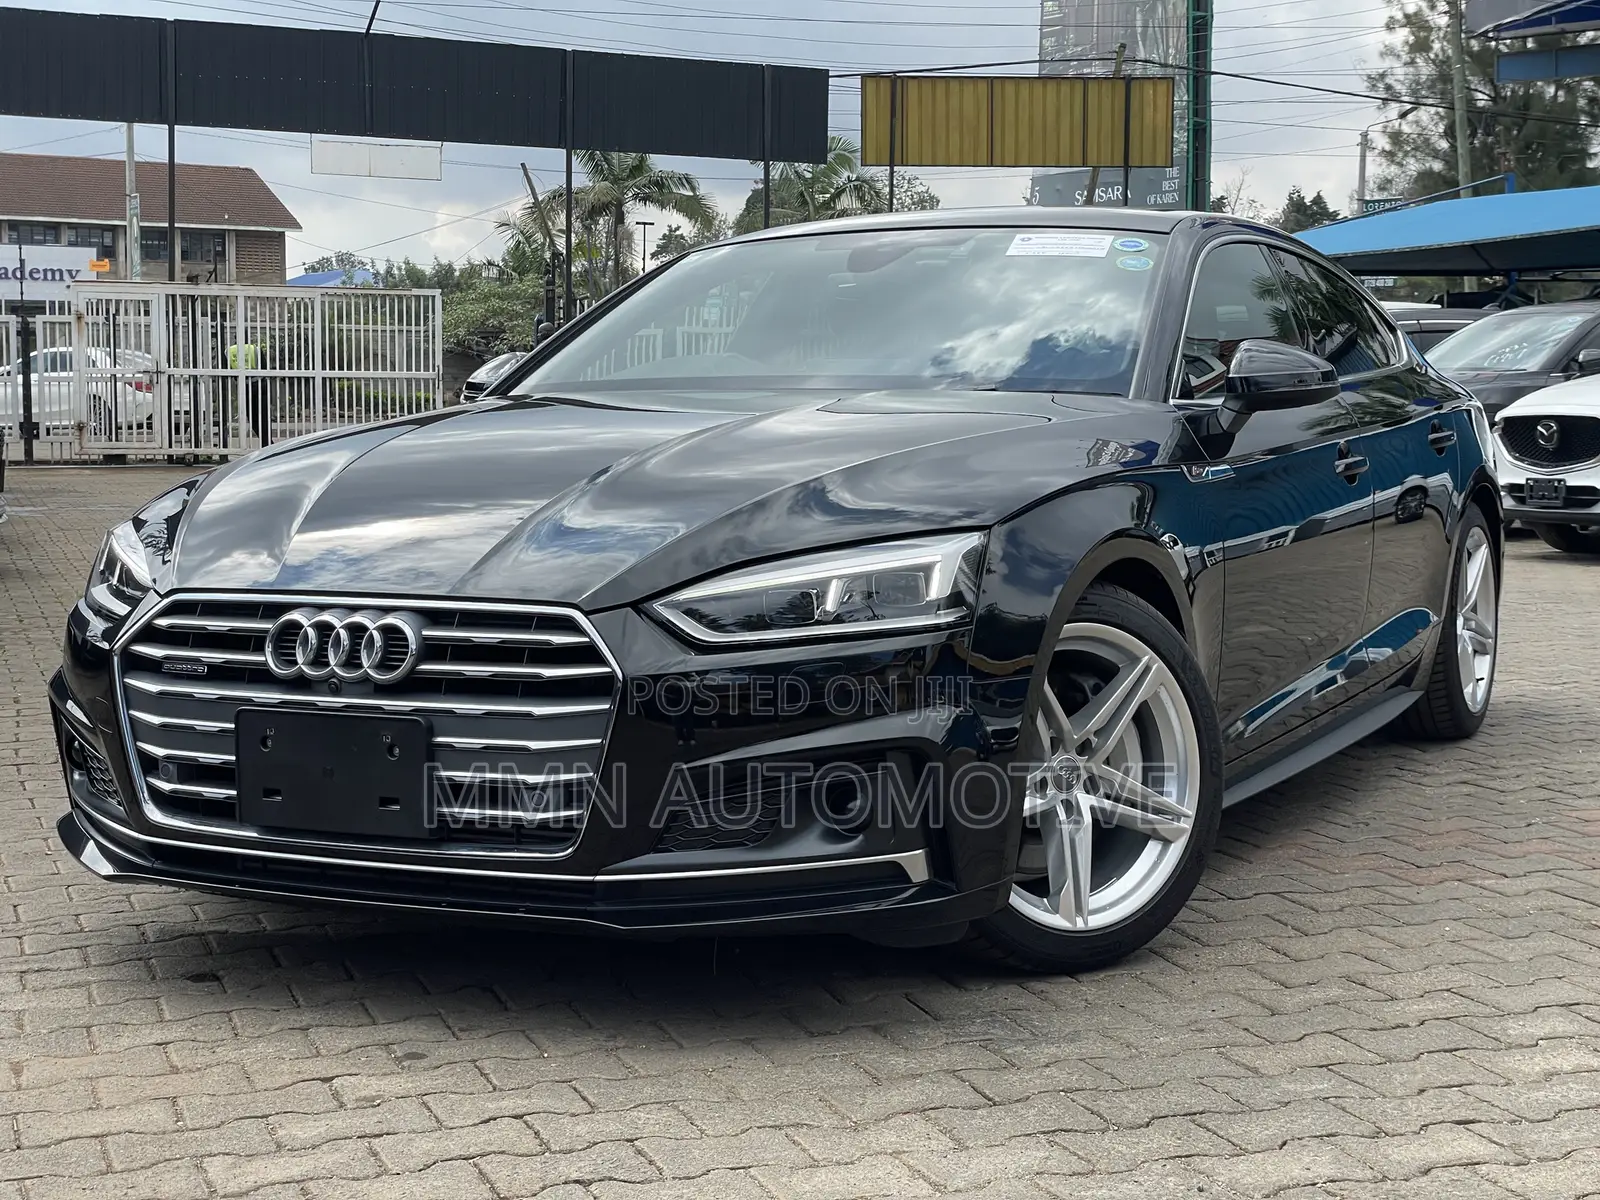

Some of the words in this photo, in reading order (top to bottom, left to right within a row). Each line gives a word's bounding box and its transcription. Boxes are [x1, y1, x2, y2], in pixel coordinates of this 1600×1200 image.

[1165, 167, 1180, 178] THE
[1162, 179, 1180, 191] BEST
[1146, 194, 1156, 206] OF
[1156, 192, 1180, 204] KAREN
